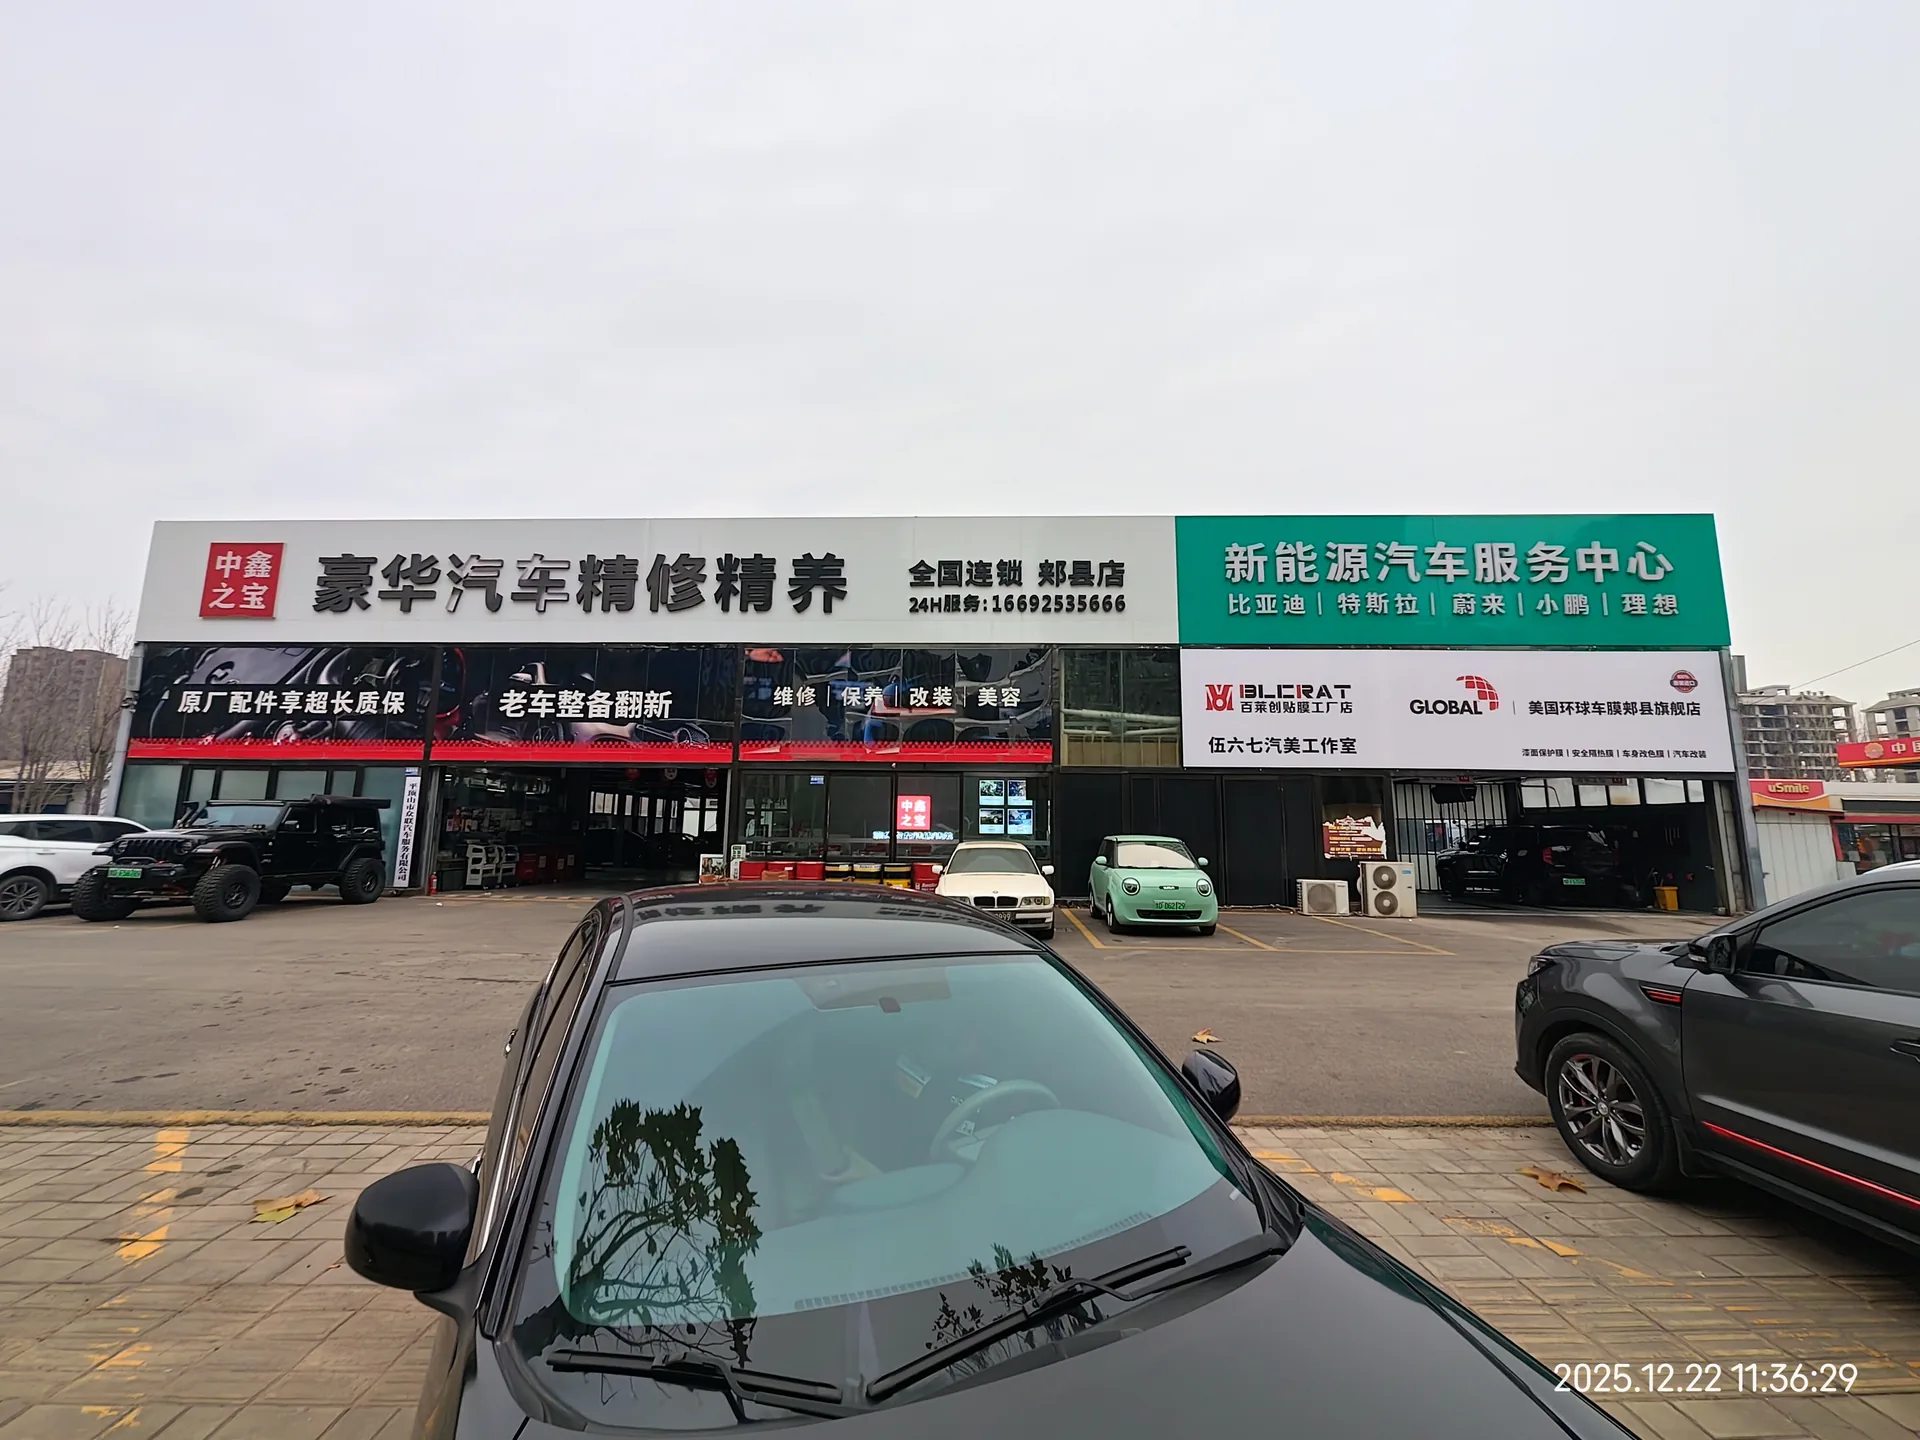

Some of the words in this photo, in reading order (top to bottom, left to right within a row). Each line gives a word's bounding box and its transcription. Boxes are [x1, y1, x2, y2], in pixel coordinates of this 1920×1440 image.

[215, 551, 272, 580] 中鑫
[909, 559, 1023, 587] 全国连锁
[1038, 559, 1125, 588] 郏县店
[1225, 541, 1673, 583] 新能源汽车服务中心
[313, 553, 847, 614] 豪华汽车精修精养
[208, 582, 268, 611] 之宝
[909, 594, 1126, 613] 24H服务:16692535666
[1229, 593, 1306, 615] 比亚迪
[1338, 592, 1419, 615] 特斯拉
[1453, 593, 1506, 615] 蔚来
[1537, 593, 1590, 615] 小鹏
[1622, 593, 1680, 616] 理想
[178, 690, 405, 715] 原厂配件享超长质保
[499, 690, 672, 719] 老车整备翻新
[774, 687, 816, 707] 维修
[841, 686, 884, 707] 保养
[909, 687, 953, 707] 改装
[977, 687, 1021, 707] 美容
[1241, 701, 1353, 714] 百莱创贴膜工厂店
[1410, 699, 1483, 715] GLOBAL
[1529, 700, 1700, 716] 美国环球车膜郏县旗舰店
[1209, 737, 1357, 754] 伍六七汽美工作室
[1768, 783, 1810, 794] uSmile
